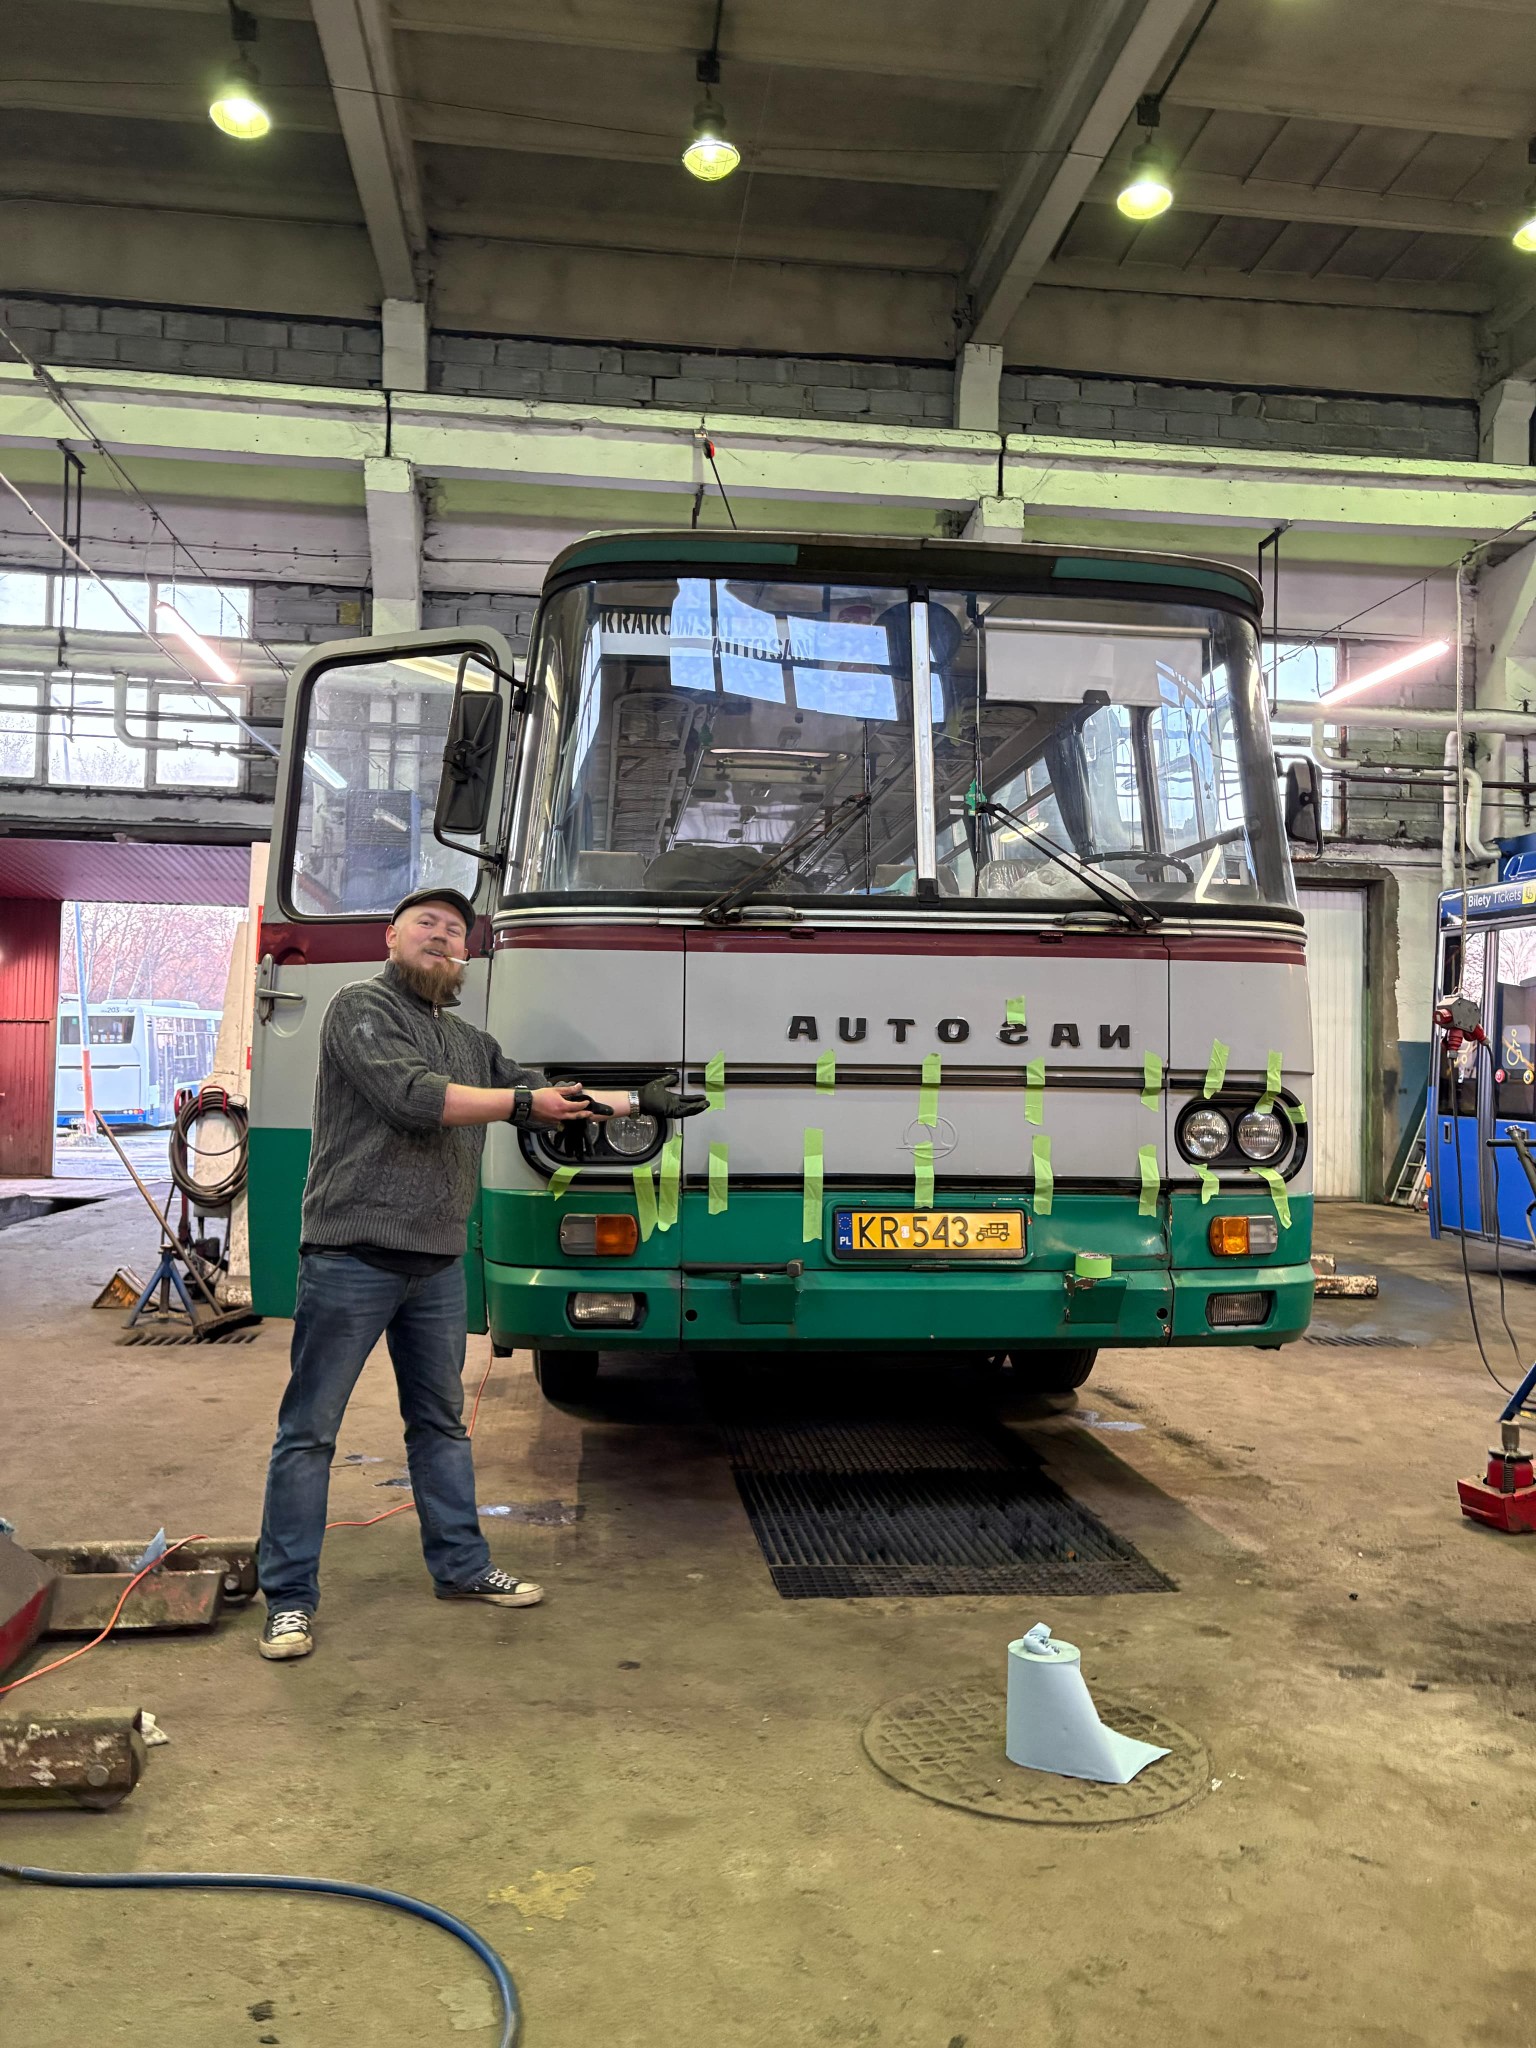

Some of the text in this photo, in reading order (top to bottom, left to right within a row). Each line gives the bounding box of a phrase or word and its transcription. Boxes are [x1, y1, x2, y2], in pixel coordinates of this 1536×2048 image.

[712, 637, 813, 661] AUTOSAN
[1468, 890, 1522, 908] Bilety Tickets
[839, 1236, 852, 1246] PL
[858, 1216, 969, 1248] KR 543
